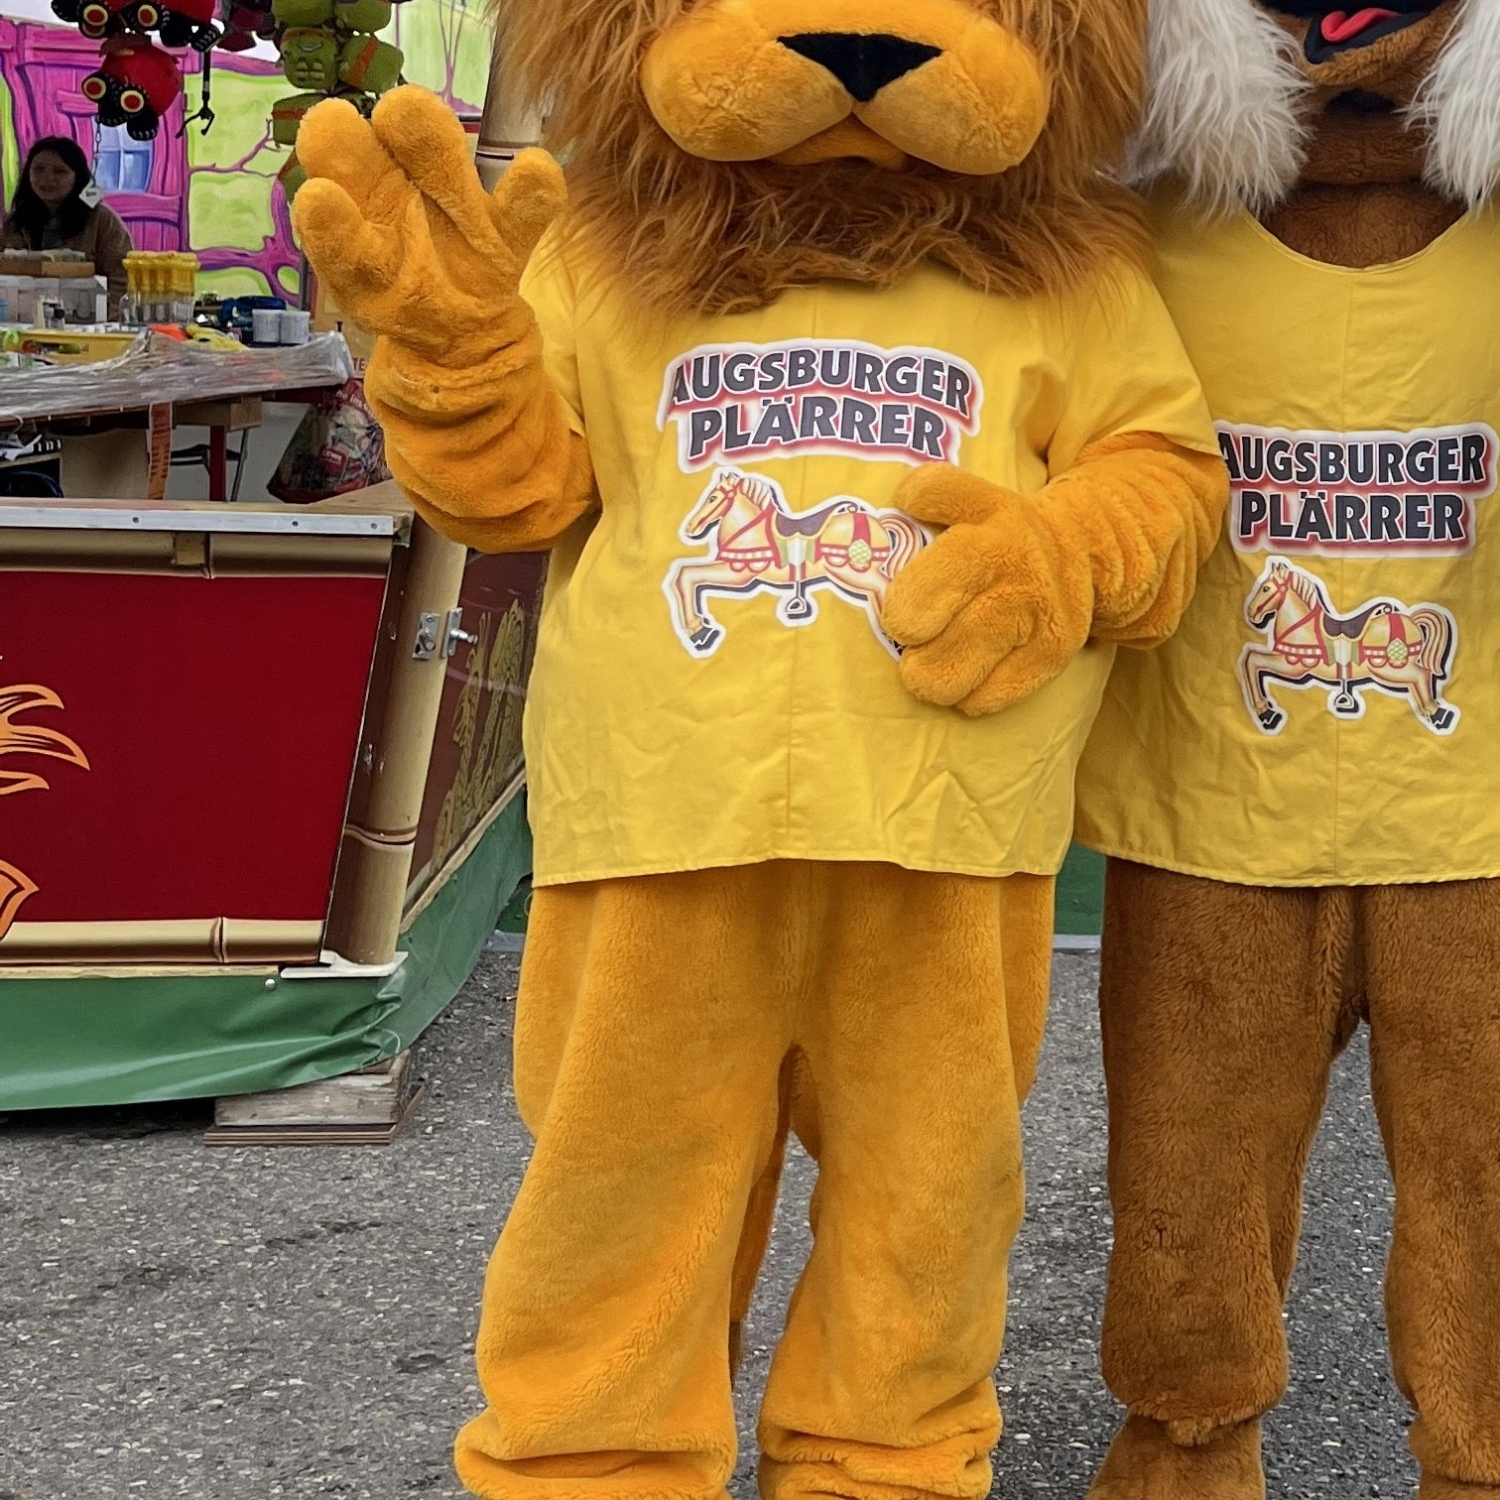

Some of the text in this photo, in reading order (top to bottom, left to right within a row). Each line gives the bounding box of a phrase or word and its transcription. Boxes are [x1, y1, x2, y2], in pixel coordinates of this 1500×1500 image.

[671, 348, 972, 418] AUGSBURGER
[687, 395, 948, 460] PLÄRRER
[1218, 431, 1487, 485] AUGSBURGER
[1239, 489, 1465, 541] PLÄRRER
